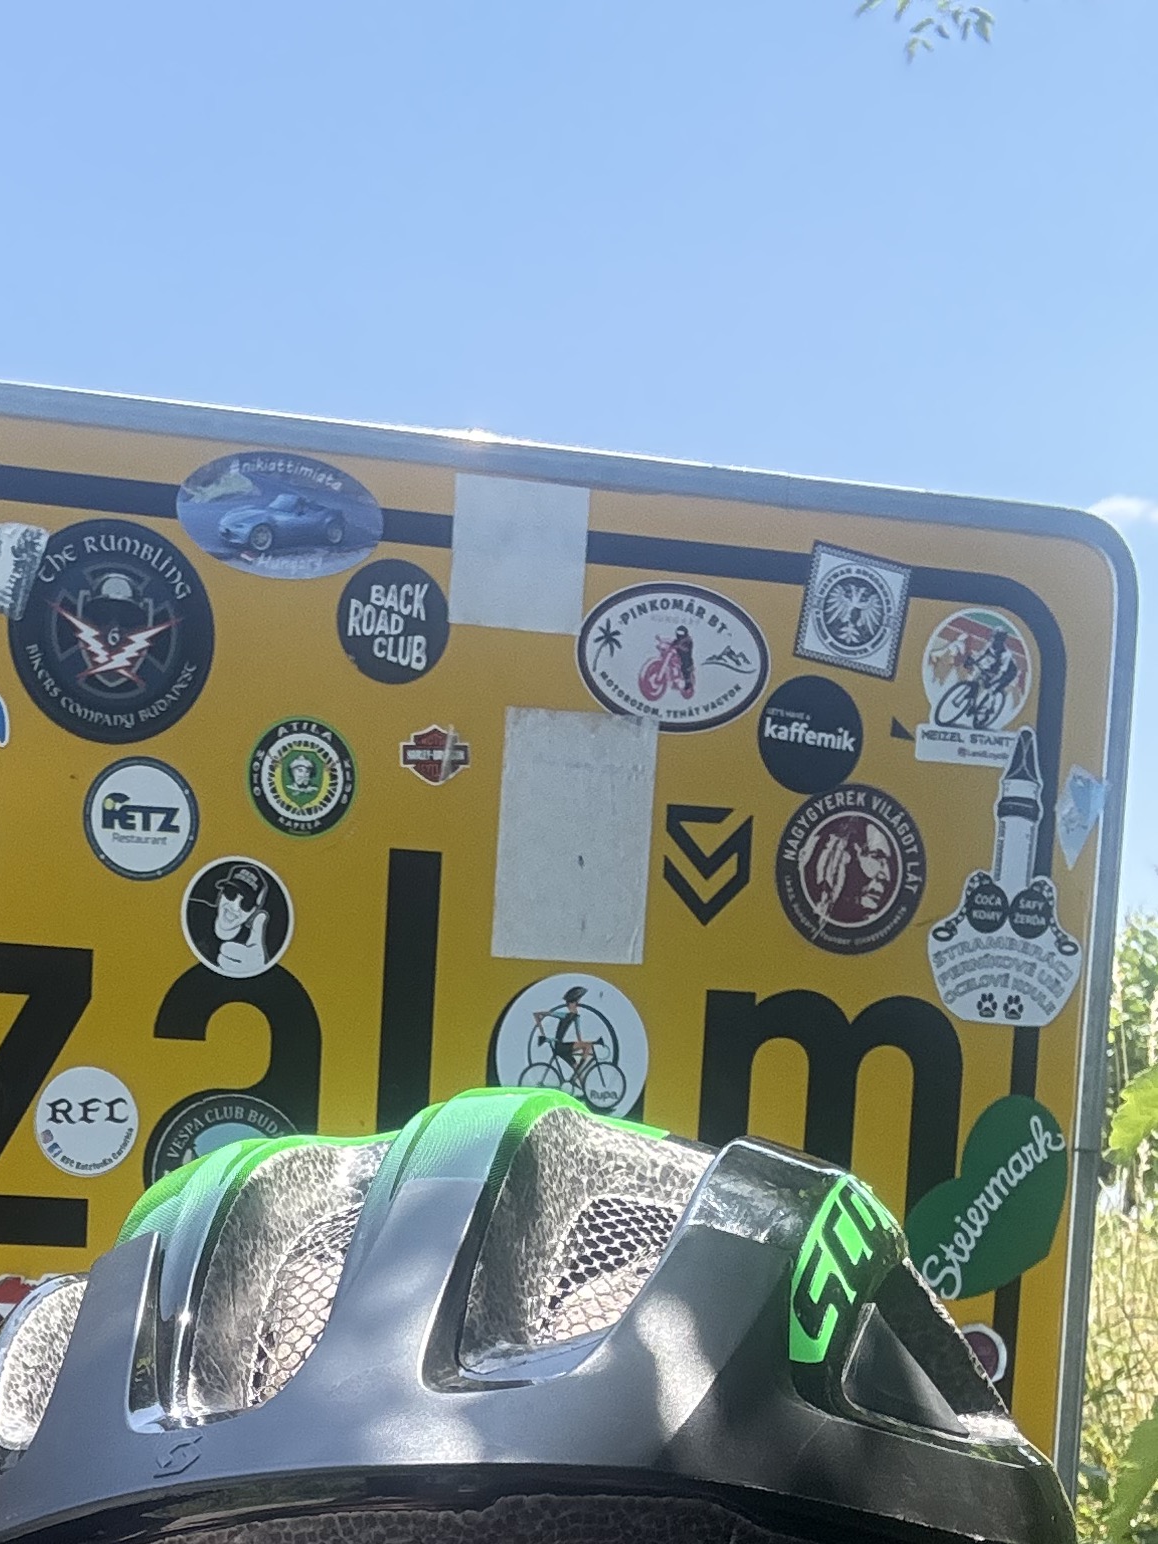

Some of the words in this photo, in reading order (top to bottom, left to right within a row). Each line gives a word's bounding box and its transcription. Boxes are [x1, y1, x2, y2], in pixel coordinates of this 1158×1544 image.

[347, 598, 405, 637] ROAD
[370, 583, 430, 621] BACK
[372, 635, 428, 672] CLUB
[764, 716, 856, 752] kaffemik
[783, 790, 867, 860] NAGYGYEREK
[166, 1117, 205, 1158] VESPA
[204, 1105, 244, 1123] CLUB
[921, 1115, 1067, 1300] Steiermark
